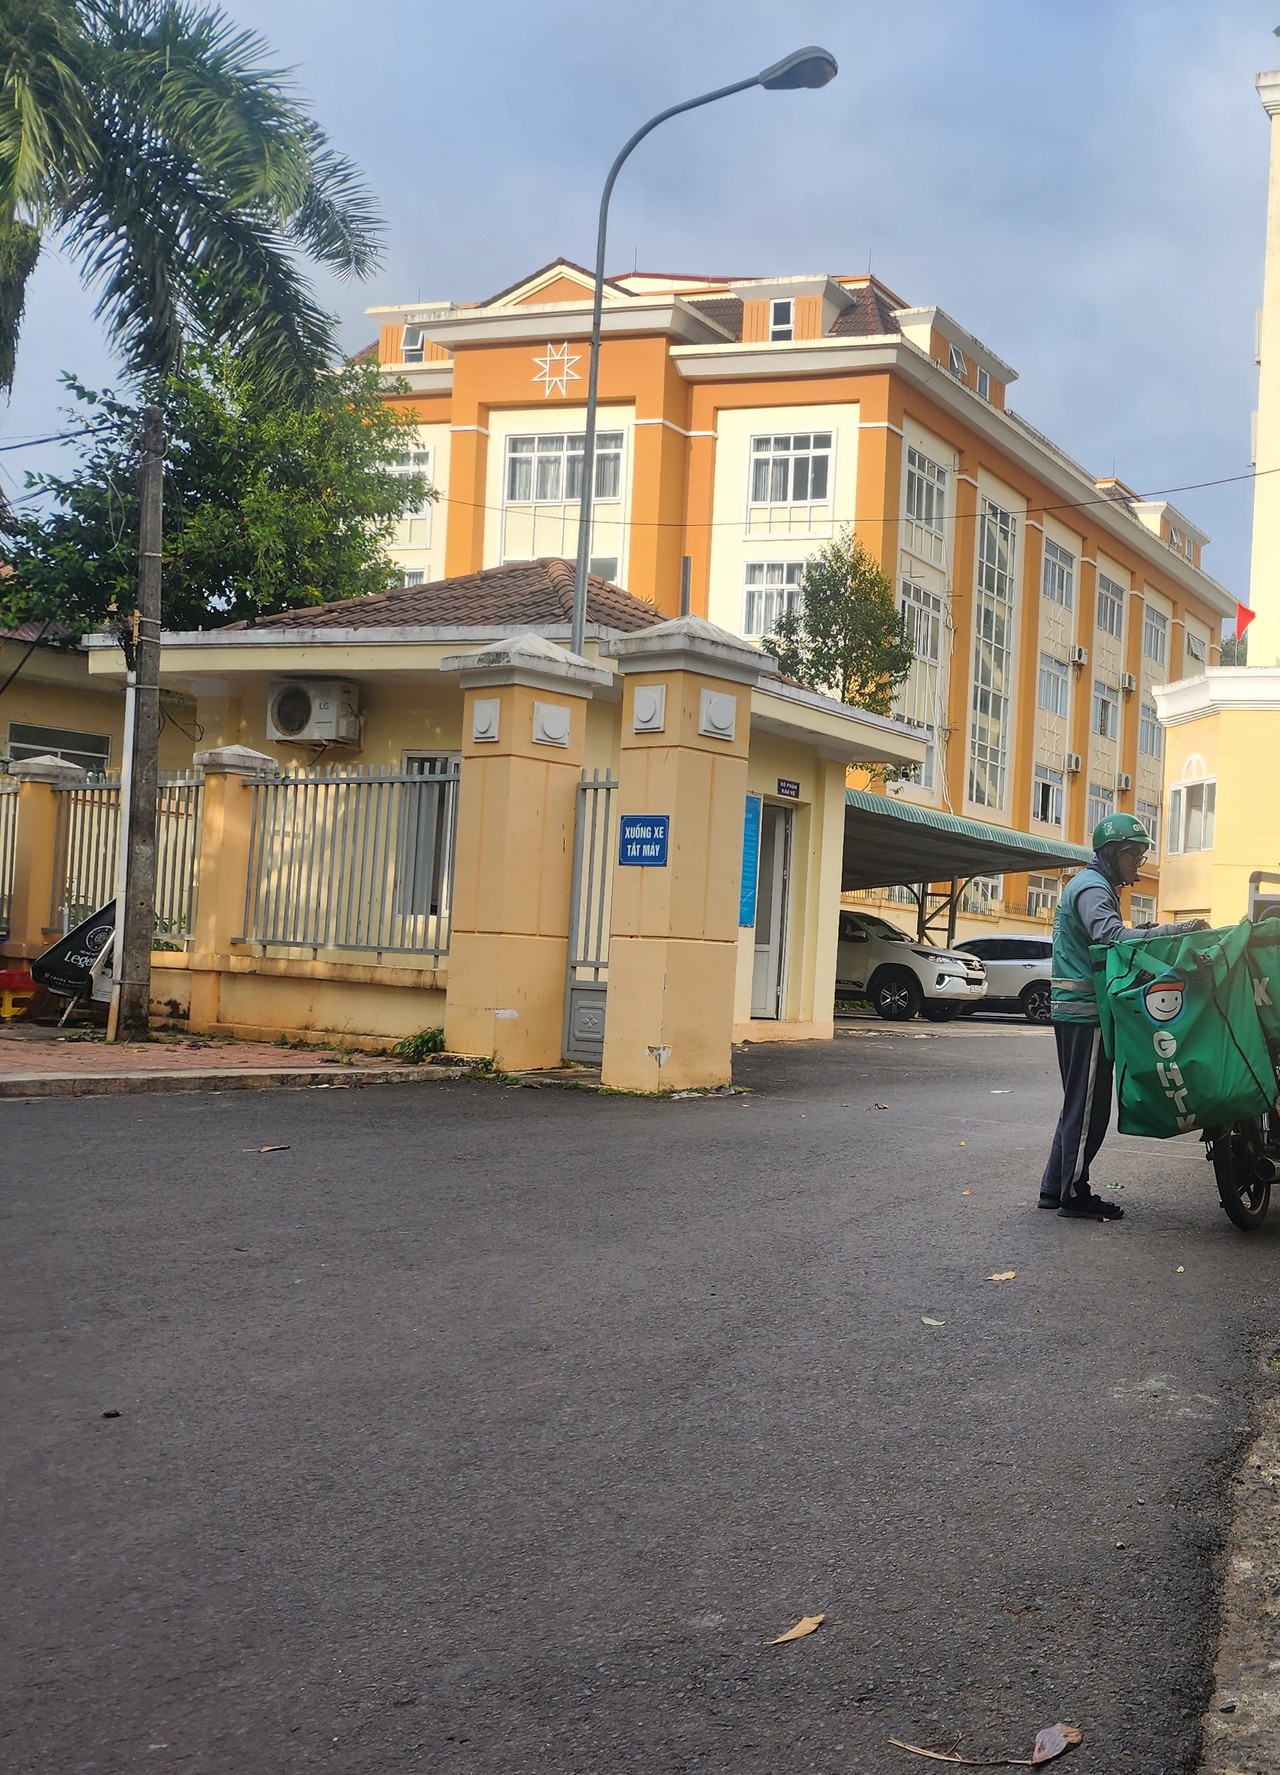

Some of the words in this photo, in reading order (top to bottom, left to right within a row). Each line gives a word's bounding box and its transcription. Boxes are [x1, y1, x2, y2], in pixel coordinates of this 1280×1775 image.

[319, 702, 330, 710] LG
[625, 822, 652, 839] XUỐNG
[654, 826, 665, 839] XE
[627, 841, 641, 857] TẮT
[642, 842, 661, 857] MÁY
[63, 950, 97, 969] Lege
